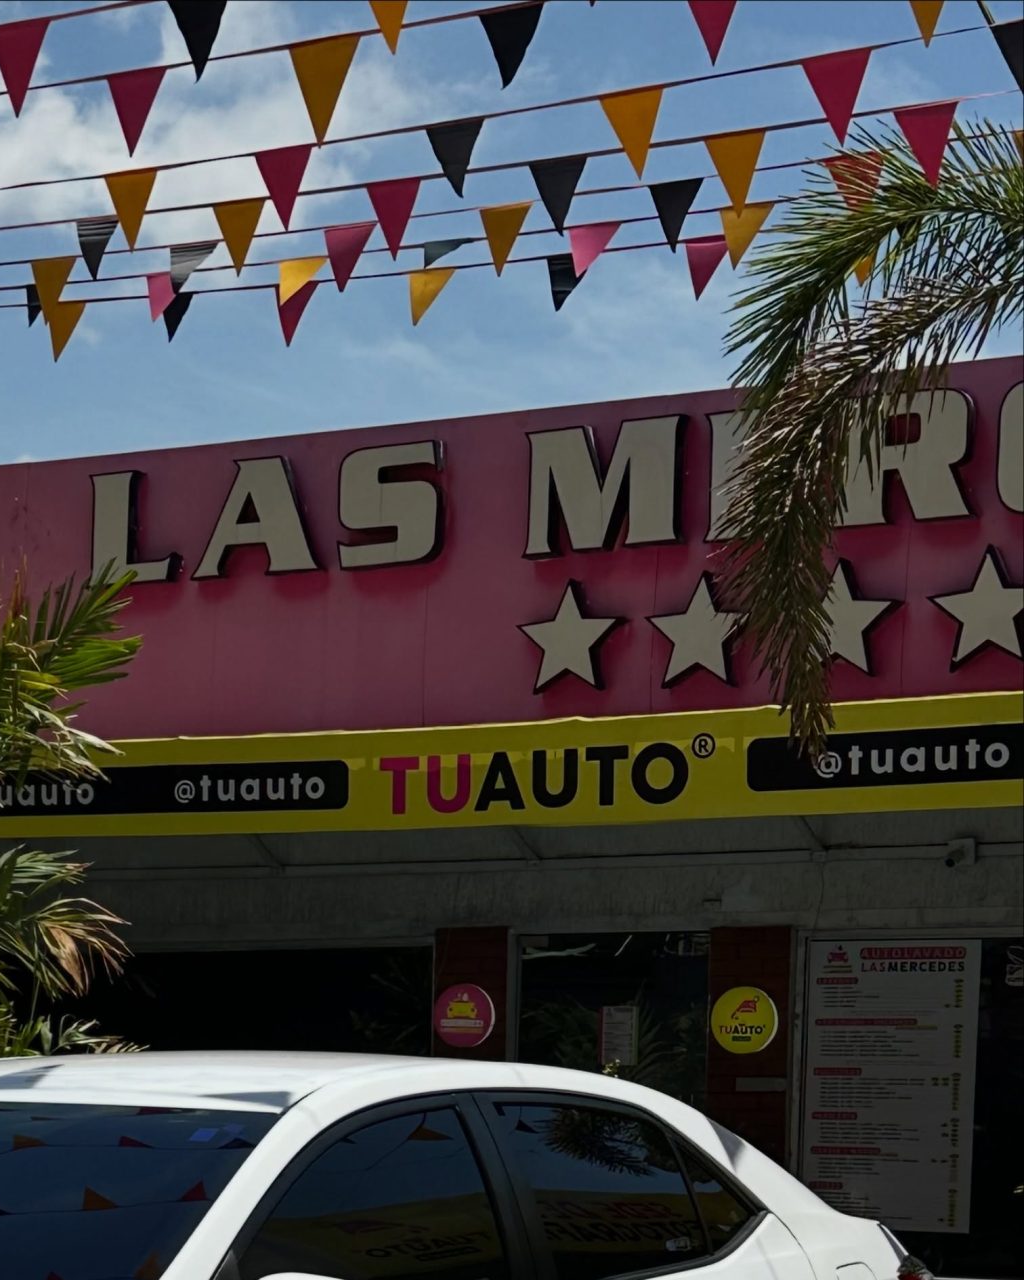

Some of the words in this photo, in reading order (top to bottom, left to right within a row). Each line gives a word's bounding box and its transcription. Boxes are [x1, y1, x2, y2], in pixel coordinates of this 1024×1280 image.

[89, 440, 446, 588] LAS
[525, 380, 1024, 558] MR
[816, 738, 1010, 779] @tuauto
[174, 772, 326, 803] @tuauto
[861, 947, 965, 959] AUTOLAVADO
